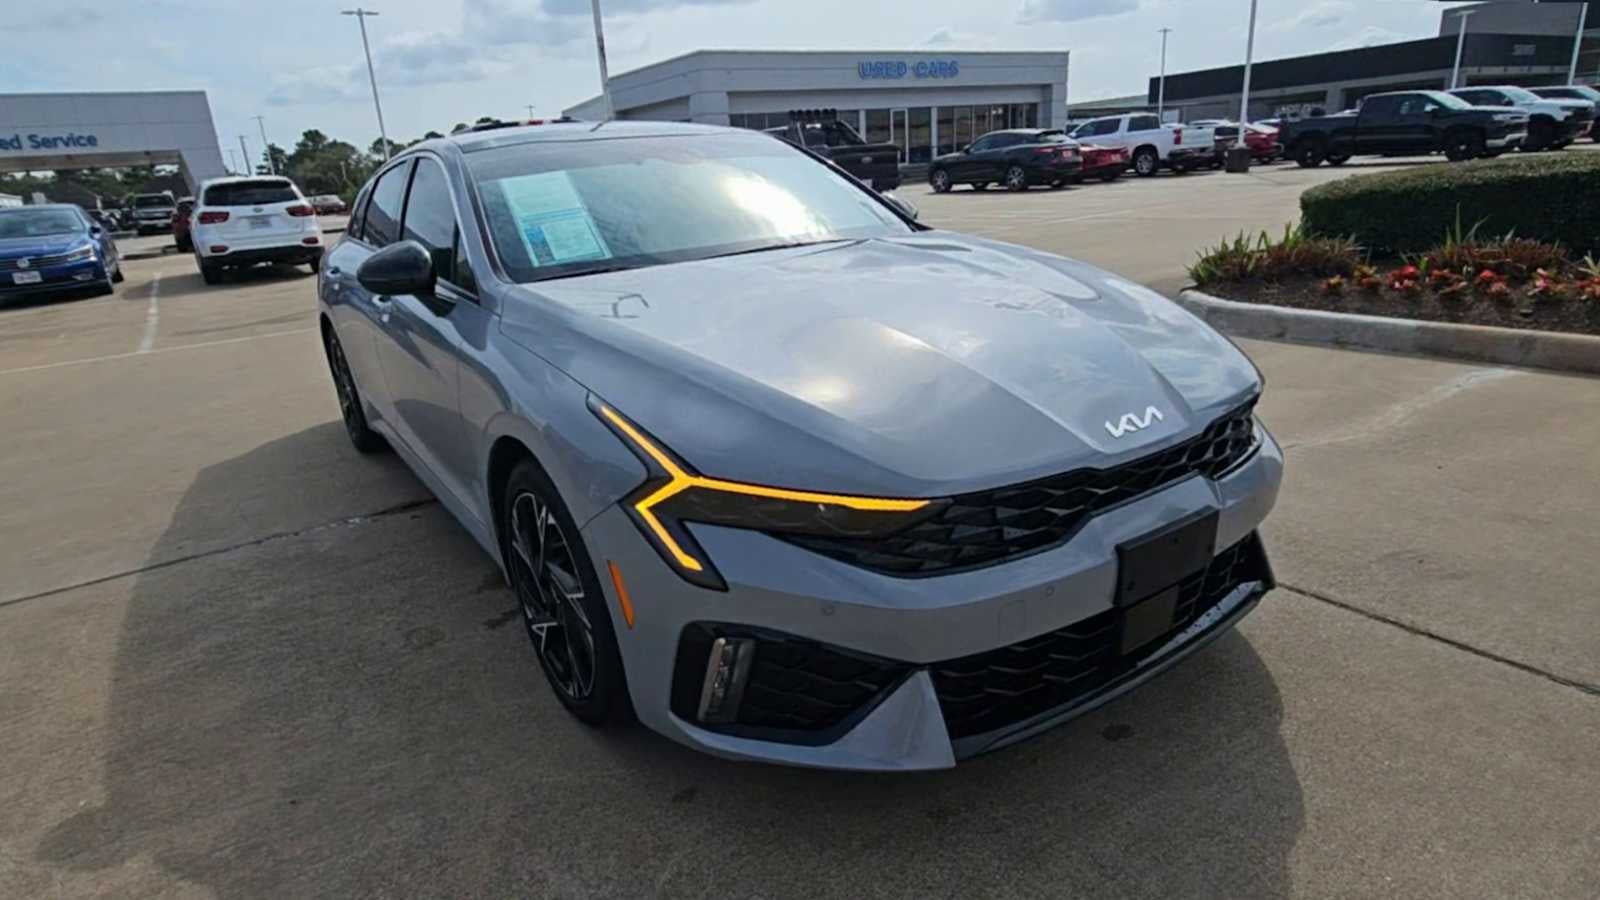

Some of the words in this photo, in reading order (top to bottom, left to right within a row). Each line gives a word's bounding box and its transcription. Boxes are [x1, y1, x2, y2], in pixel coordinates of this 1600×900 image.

[858, 61, 908, 80] USED
[914, 60, 959, 79] CARS
[27, 132, 98, 149] Service
[1105, 405, 1163, 438] KIA
